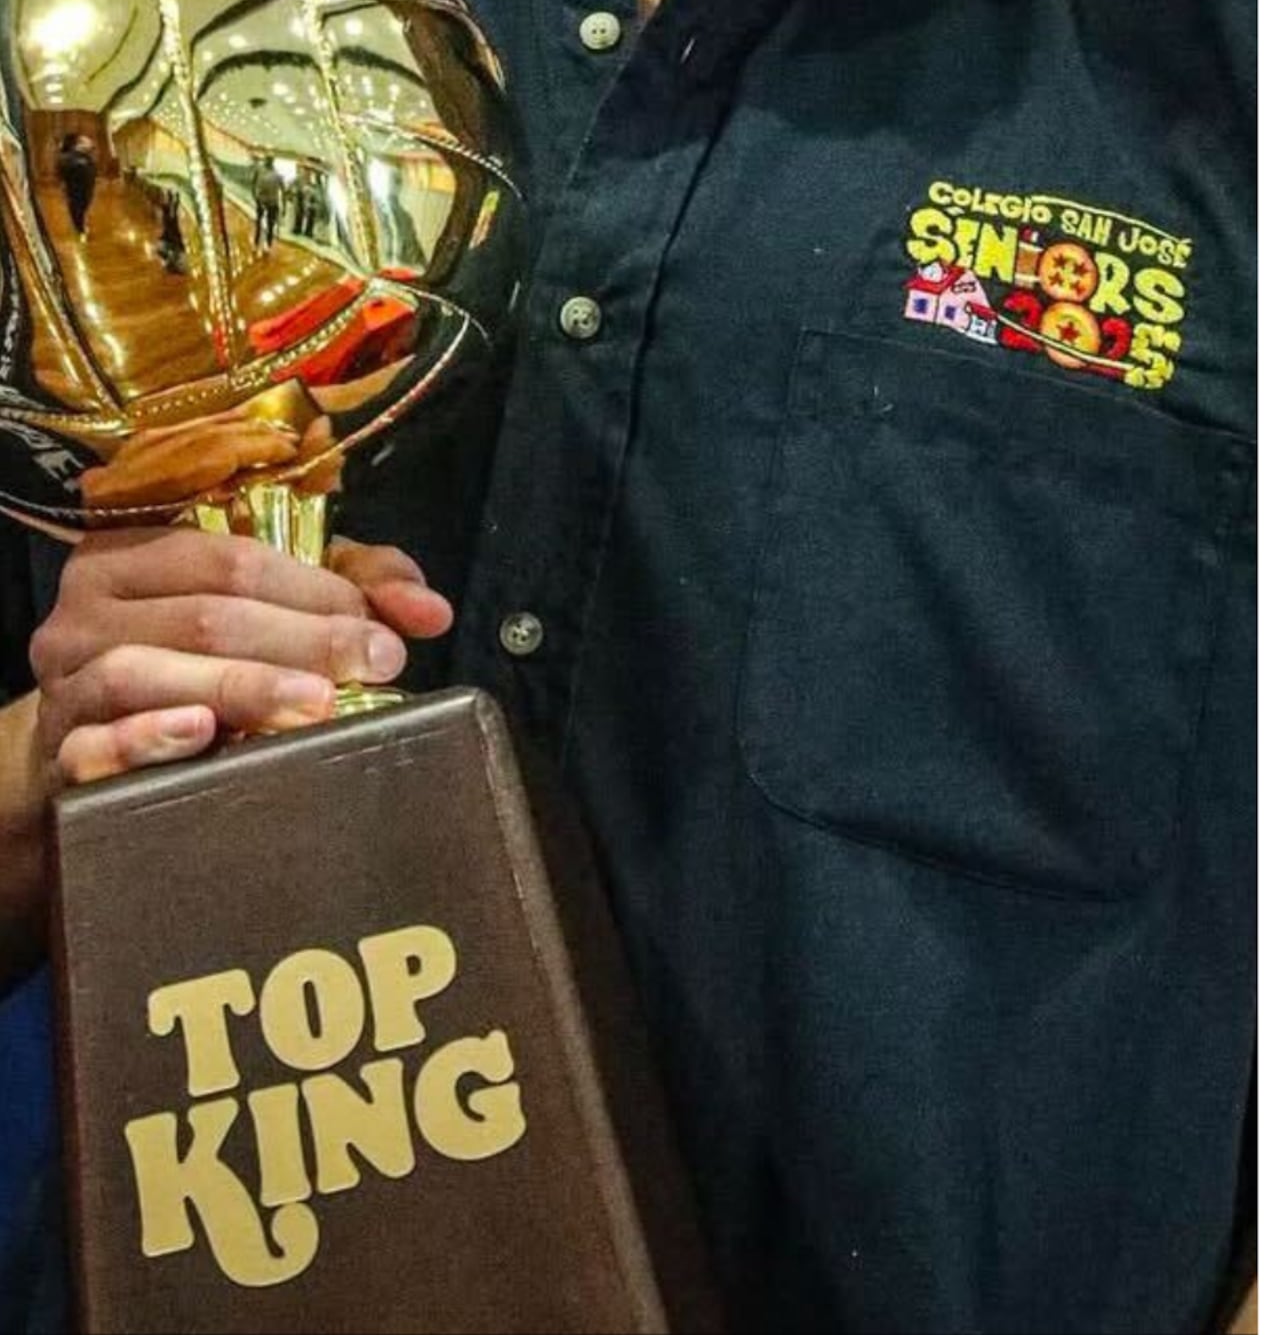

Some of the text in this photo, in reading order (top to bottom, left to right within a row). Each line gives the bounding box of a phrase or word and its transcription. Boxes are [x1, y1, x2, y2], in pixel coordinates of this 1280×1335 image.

[928, 181, 1193, 270] COLEGIO SAN JOSÉ
[147, 924, 458, 1098] TOP
[124, 1029, 528, 1288] KING
